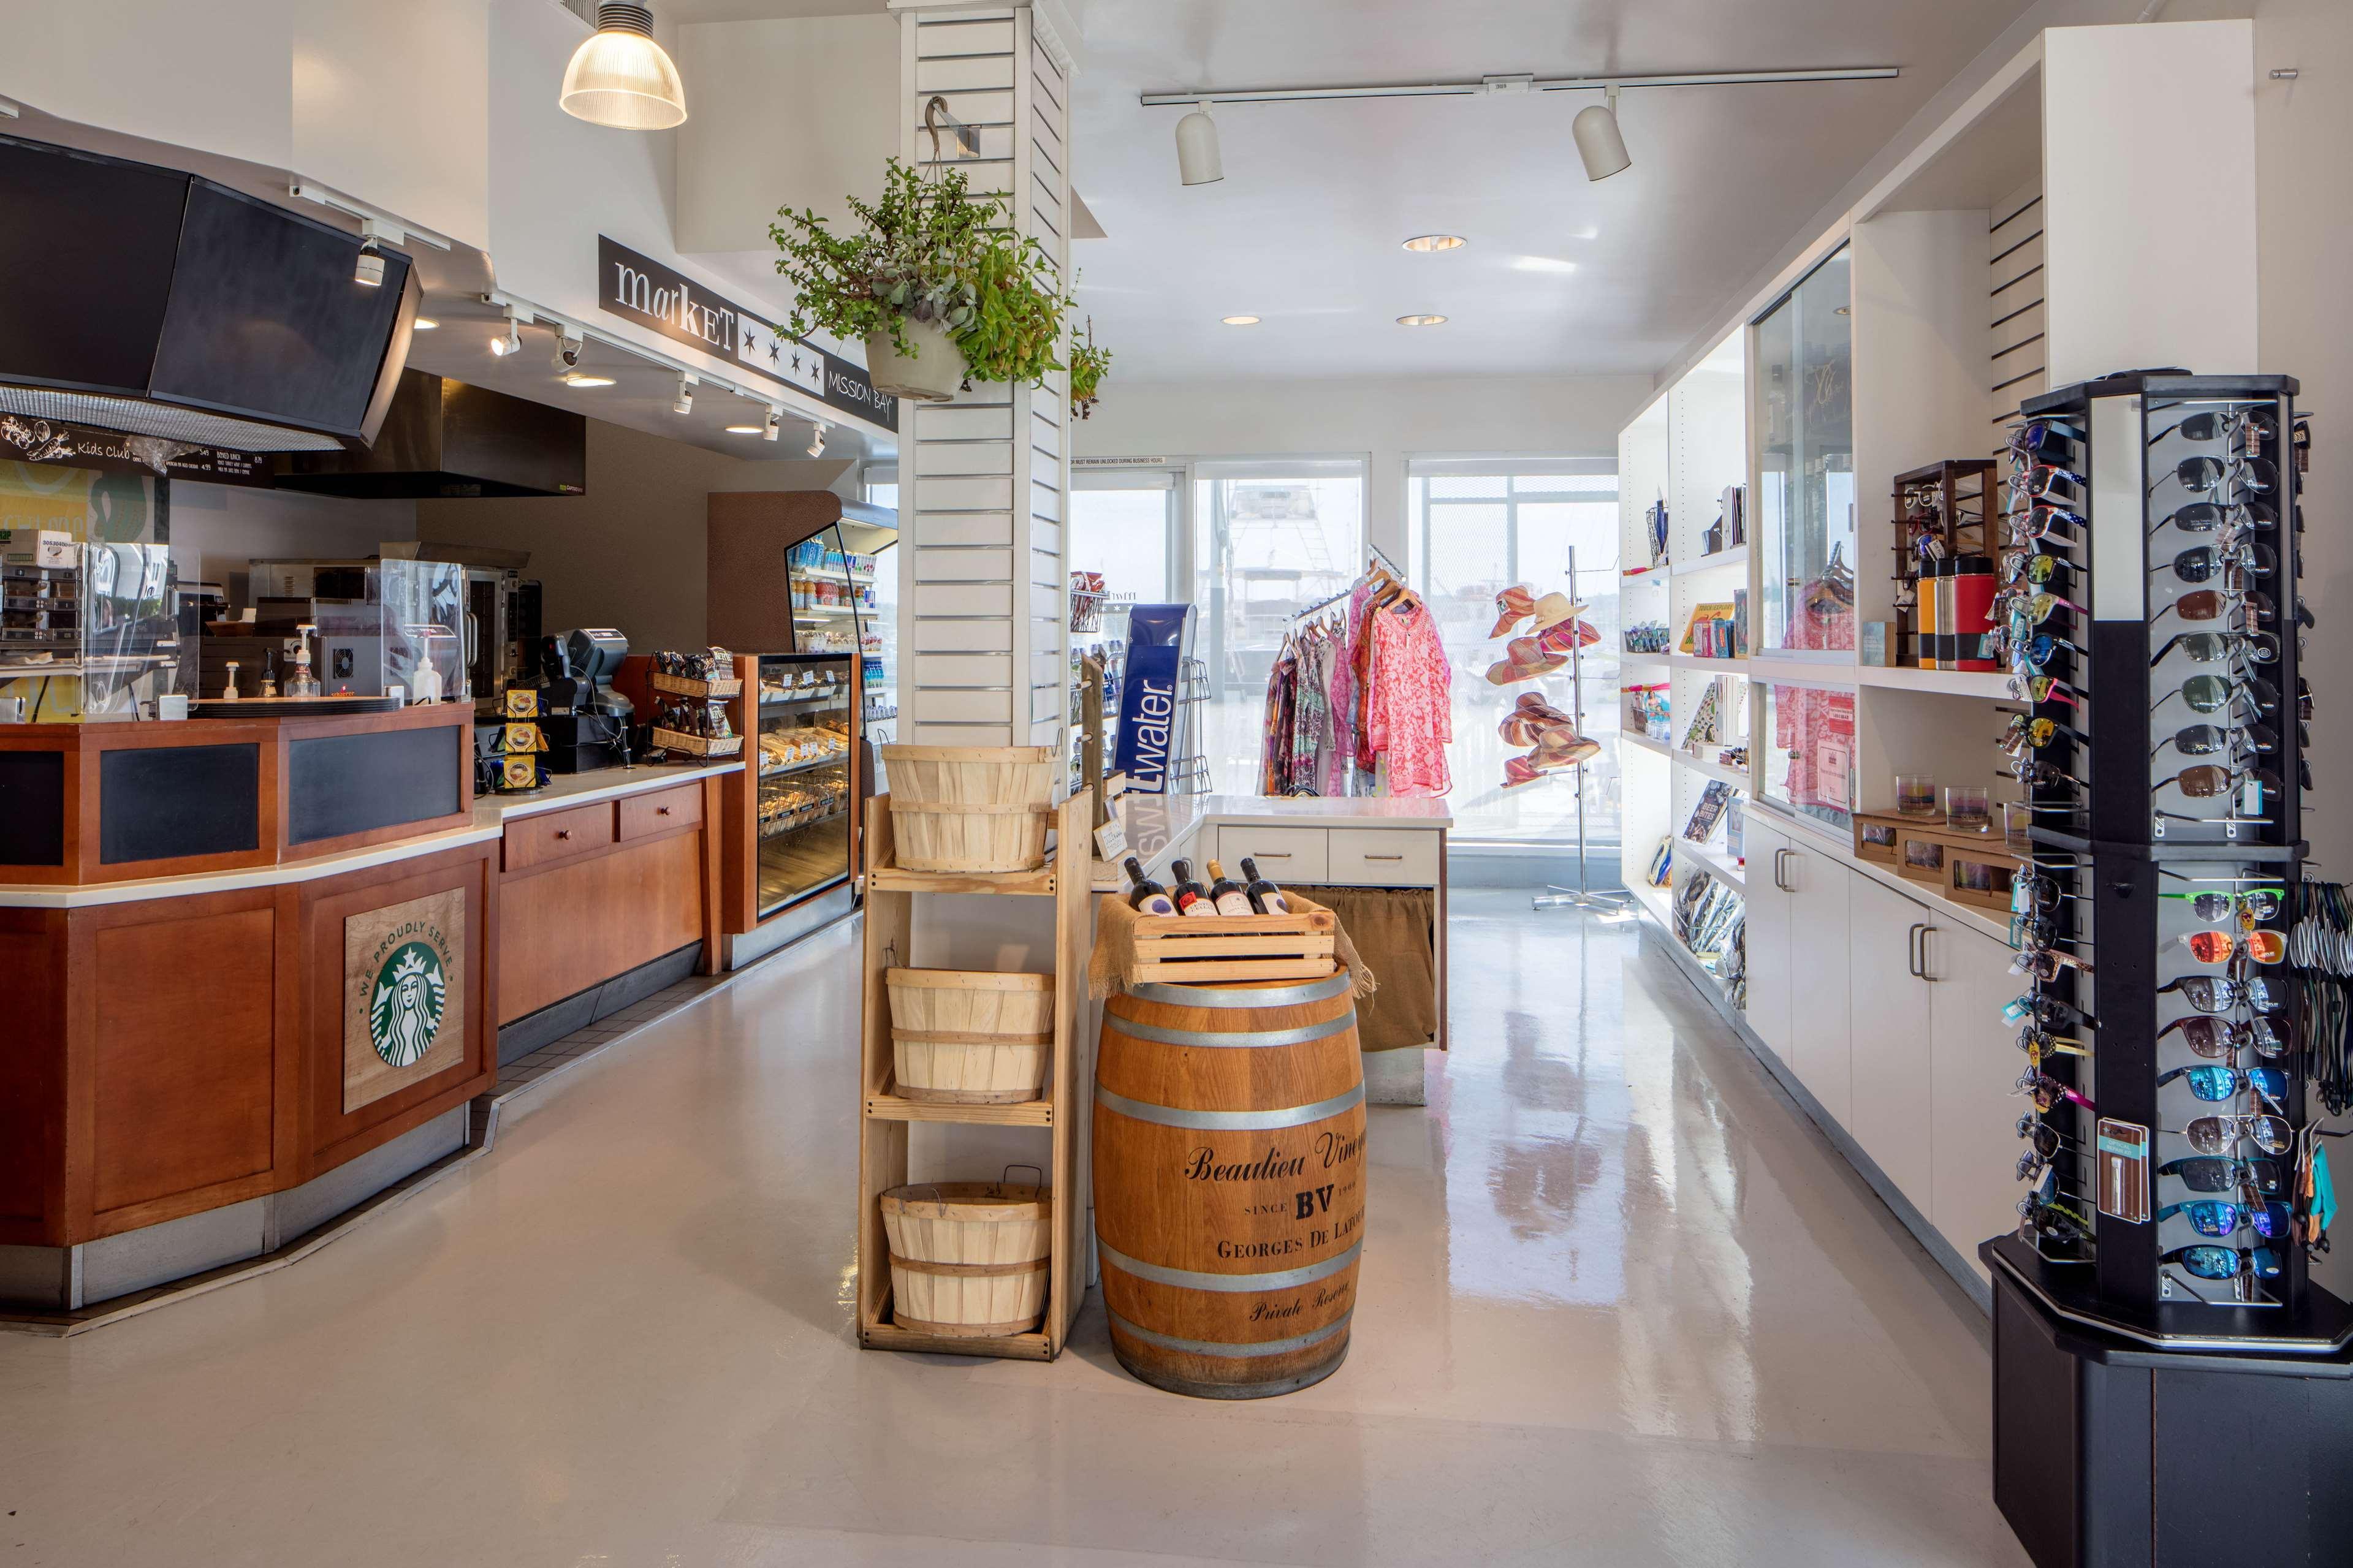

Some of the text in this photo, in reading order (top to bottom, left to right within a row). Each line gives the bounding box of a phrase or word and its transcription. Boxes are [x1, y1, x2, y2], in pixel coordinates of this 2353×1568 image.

[828, 370, 892, 422] MISSION BAY
[78, 441, 129, 460] Kids Club
[216, 451, 229, 460] BOXED
[1698, 809, 1715, 820] BITES
[1702, 803, 1719, 812] BEER
[360, 920, 453, 997] WE PROUDLY SERVE
[2107, 1145, 2124, 1154] REPAIR
[2108, 1140, 2129, 1149] OPTICAL
[1185, 1146, 1306, 1182] Beaulieu
[1244, 1181, 1356, 1221] SINCE BV 1900
[1217, 1237, 1303, 1259] GEORGES
[1249, 1280, 1350, 1322] Private Reserve
